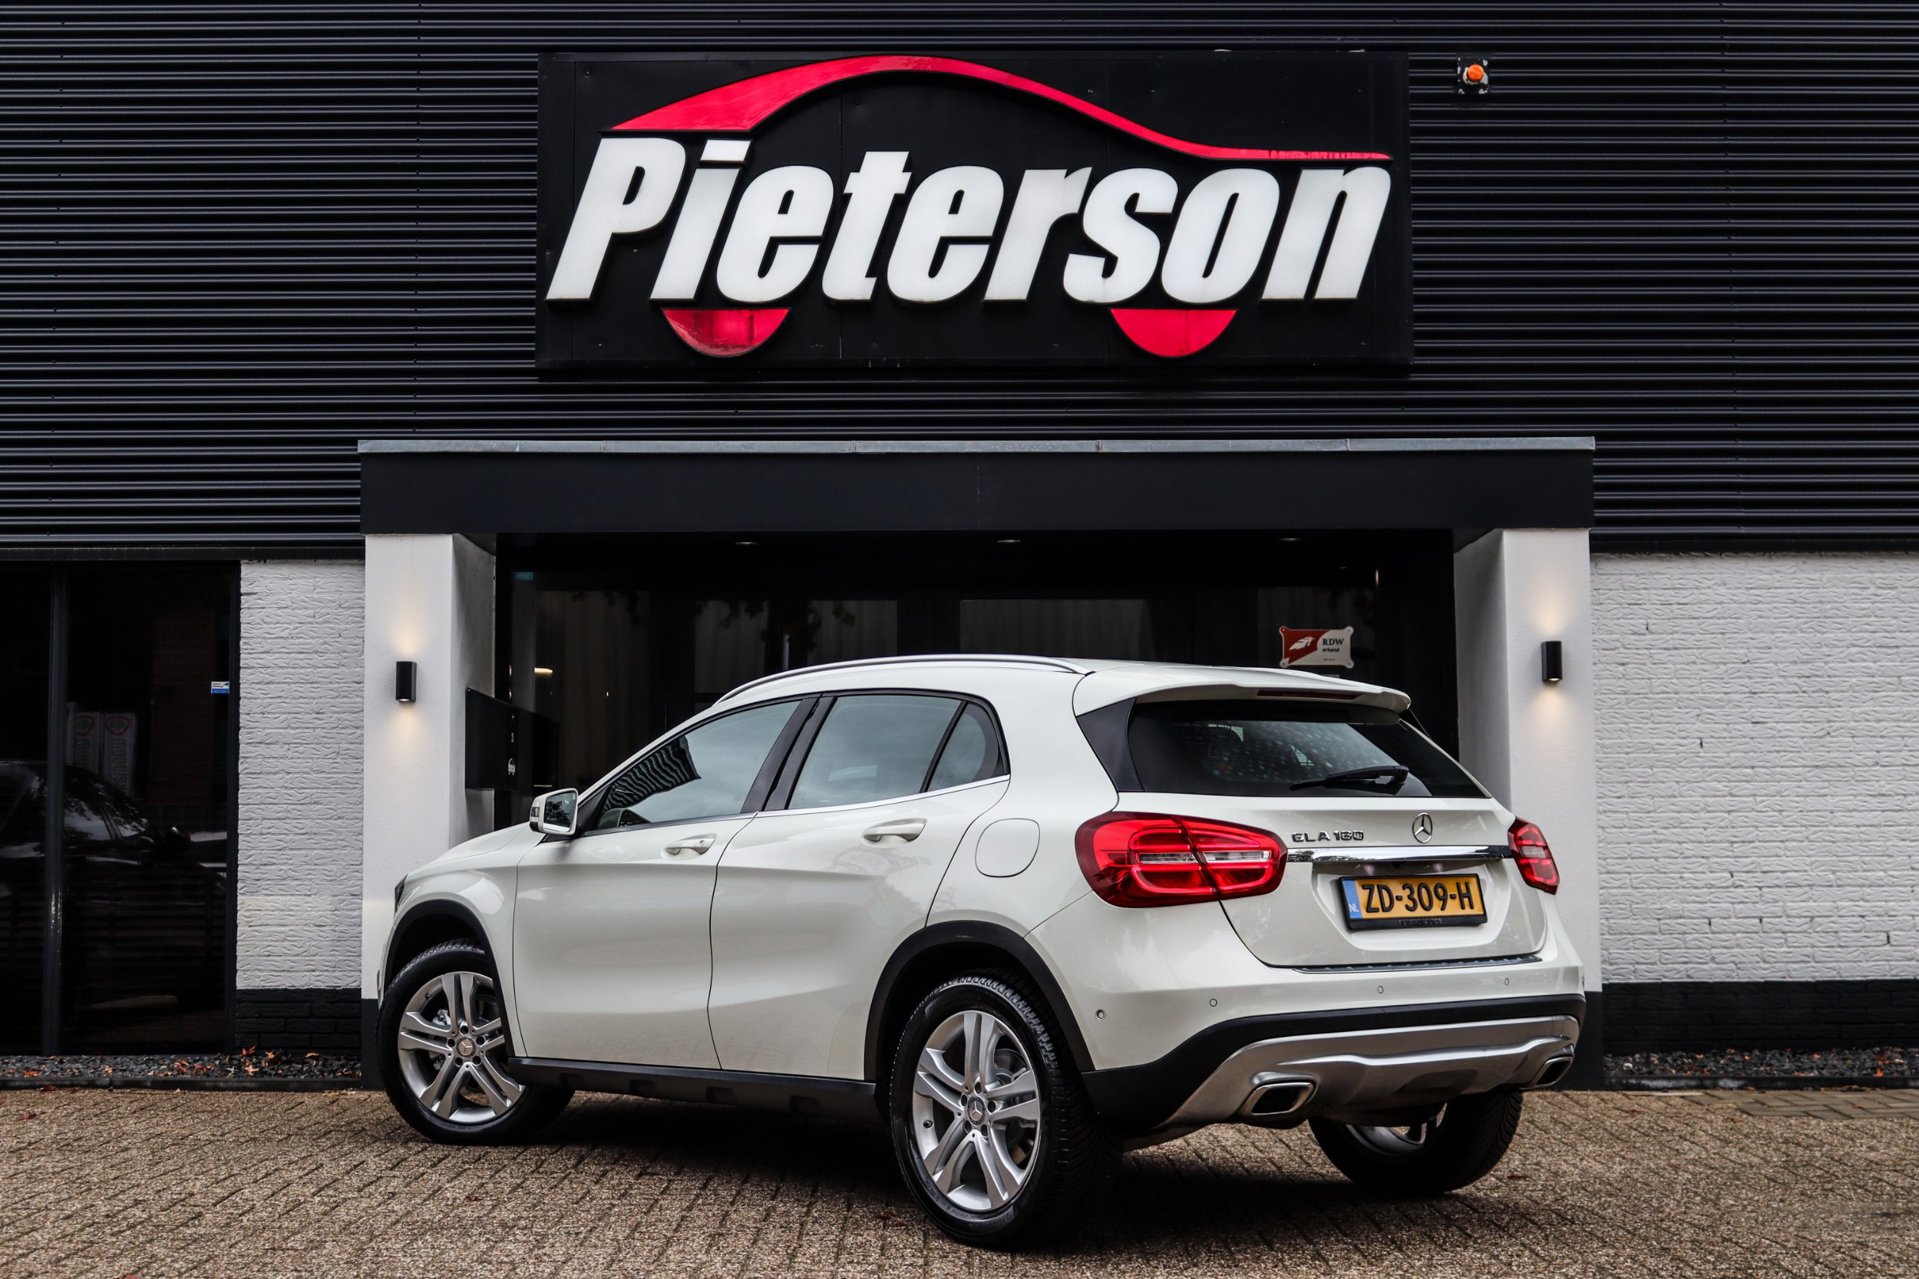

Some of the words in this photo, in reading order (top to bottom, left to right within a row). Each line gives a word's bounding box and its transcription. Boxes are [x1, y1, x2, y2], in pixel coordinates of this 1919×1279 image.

[546, 136, 1391, 303] Pieterson
[1322, 638, 1345, 646] RDW
[1291, 831, 1331, 843] GLA
[1361, 881, 1475, 914] ZD-309-H
[1348, 903, 1360, 913] NL
